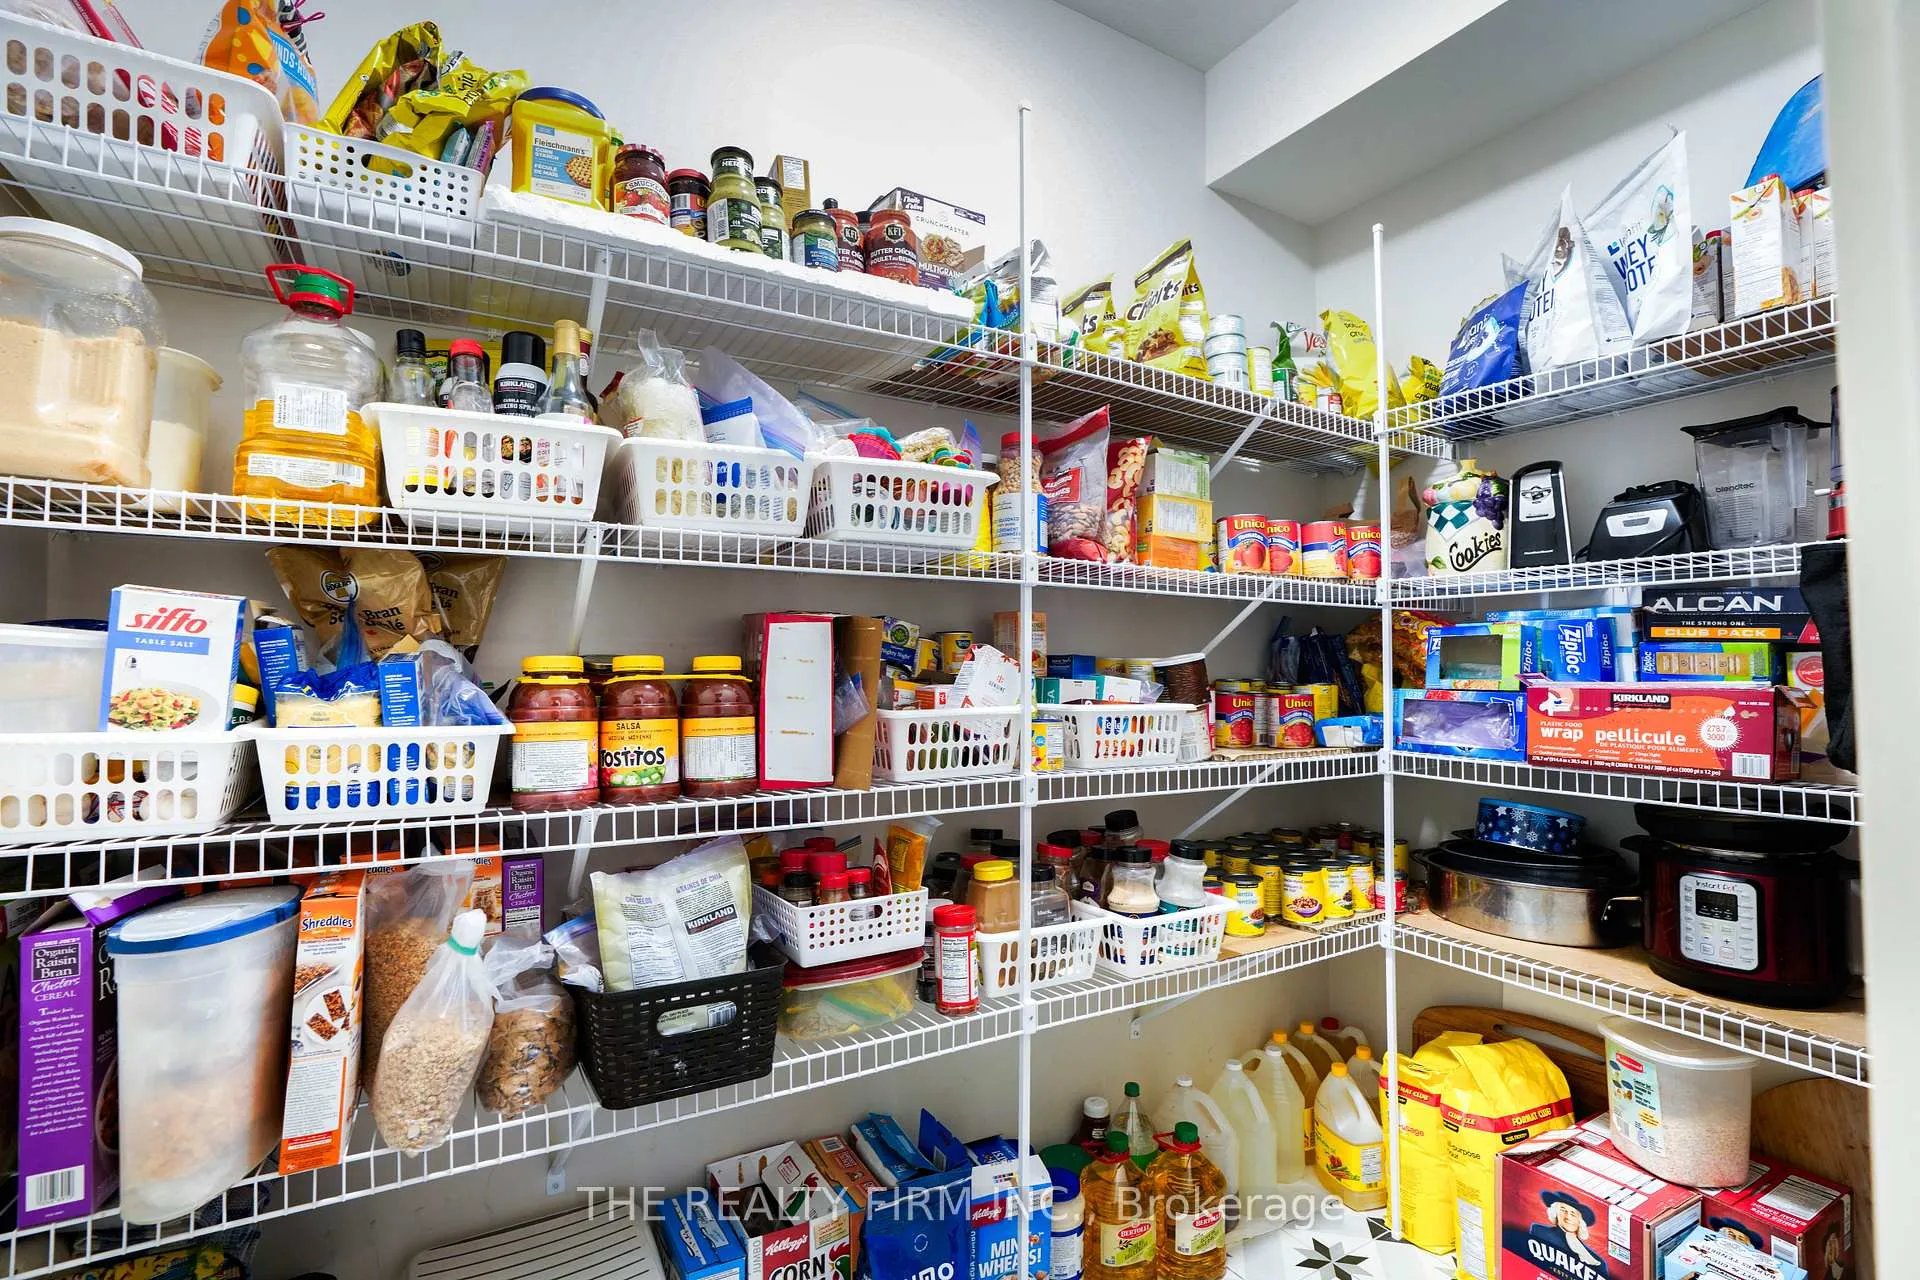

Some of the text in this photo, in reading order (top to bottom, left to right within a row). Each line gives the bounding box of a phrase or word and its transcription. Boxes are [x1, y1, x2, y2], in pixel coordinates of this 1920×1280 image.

[534, 137, 585, 155] Fleischmann's
[887, 225, 902, 236] KFI
[915, 215, 969, 237] CRUNCHMASTER
[845, 227, 858, 240] KFI
[500, 380, 535, 389] KIRKLAND
[1714, 481, 1756, 495] blendtec
[1233, 519, 1265, 530] Unico
[1267, 524, 1290, 534] nico
[1351, 530, 1381, 541] Unico
[1448, 531, 1503, 571] Cookies
[1650, 595, 1784, 612] ALCAN
[362, 606, 402, 621] Bran
[125, 607, 208, 634] sifto
[1664, 628, 1767, 637] CLUB PACK
[135, 637, 195, 648] TABLE SALT
[1564, 627, 1583, 675] Ziploc
[1285, 698, 1312, 709] Unico
[1612, 693, 1670, 704] KIRKLAND
[616, 722, 641, 731] SALSA
[1706, 724, 1727, 733] 278.7
[1540, 727, 1687, 746] wrap pellicule
[1707, 733, 1726, 742] 3000
[1609, 743, 1649, 751] PLASTIQUE
[511, 876, 536, 884] Raisin
[513, 882, 534, 892] Bran
[302, 915, 353, 931] Shreddies
[687, 906, 735, 930] KIRKLAND
[35, 946, 77, 959] Organic
[35, 956, 77, 969] Raisin
[40, 968, 73, 979] Bran
[31, 976, 81, 994] Clusters
[34, 990, 77, 1002] CEREAL
[1511, 1107, 1552, 1127] FORMAT CLUB
[1120, 1223, 1150, 1237] BERTOLLI
[764, 1233, 809, 1257] Kellogg's
[990, 1236, 1021, 1260] MIN
[752, 1239, 761, 1274] JUMBO
[978, 1247, 1042, 1279] WHEAS!
[1528, 1239, 1607, 1280] QUAKE
[768, 1253, 827, 1280] CORN
